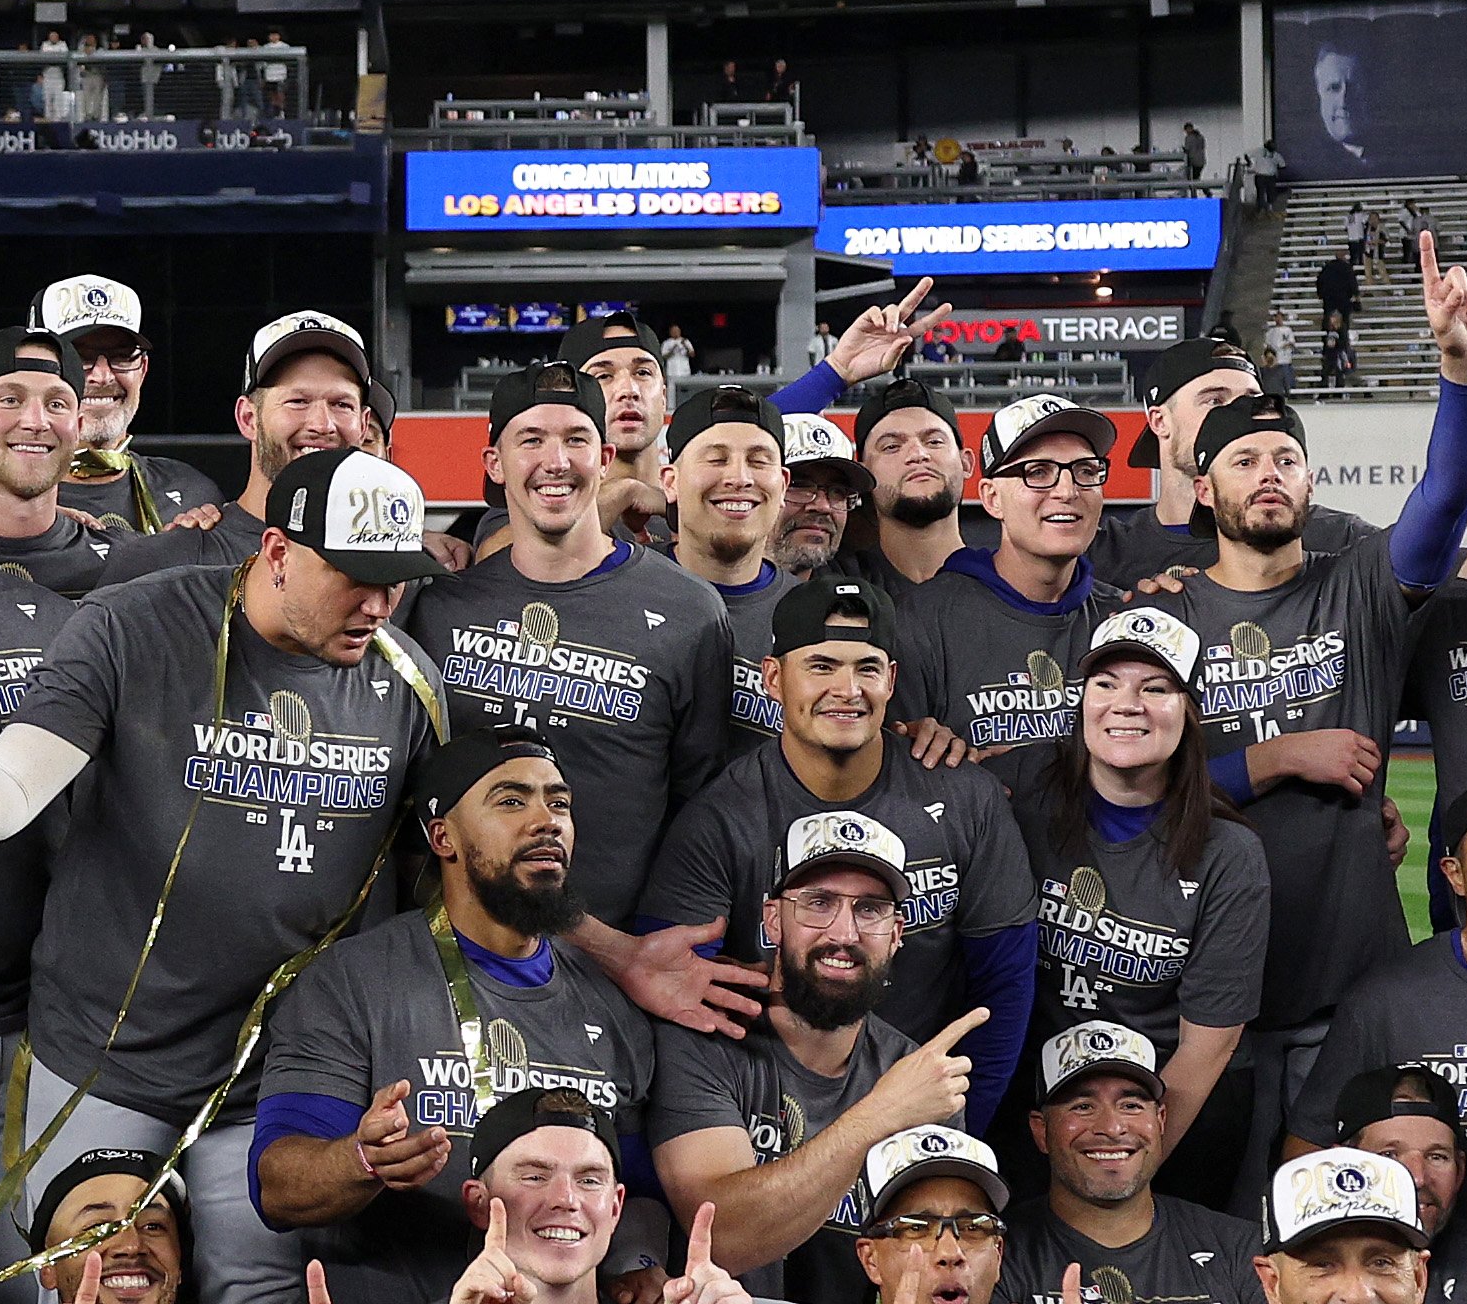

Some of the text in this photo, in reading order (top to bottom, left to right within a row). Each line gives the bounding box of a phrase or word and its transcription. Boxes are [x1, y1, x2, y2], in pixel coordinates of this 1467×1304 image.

[512, 161, 710, 191] CONGRATULATIONS
[443, 190, 782, 217] LOS ANGELES DODGERS
[844, 220, 1190, 255] 2024 WORLD SERIES CHAMPIONS
[1042, 315, 1178, 342] TERRACE
[451, 628, 652, 688] WORLD SERIES
[442, 654, 643, 724] CHAMPIONS
[191, 724, 392, 774] WORLD SERIES
[184, 754, 387, 809] CHAMPIONS
[246, 811, 335, 832] 20 24
